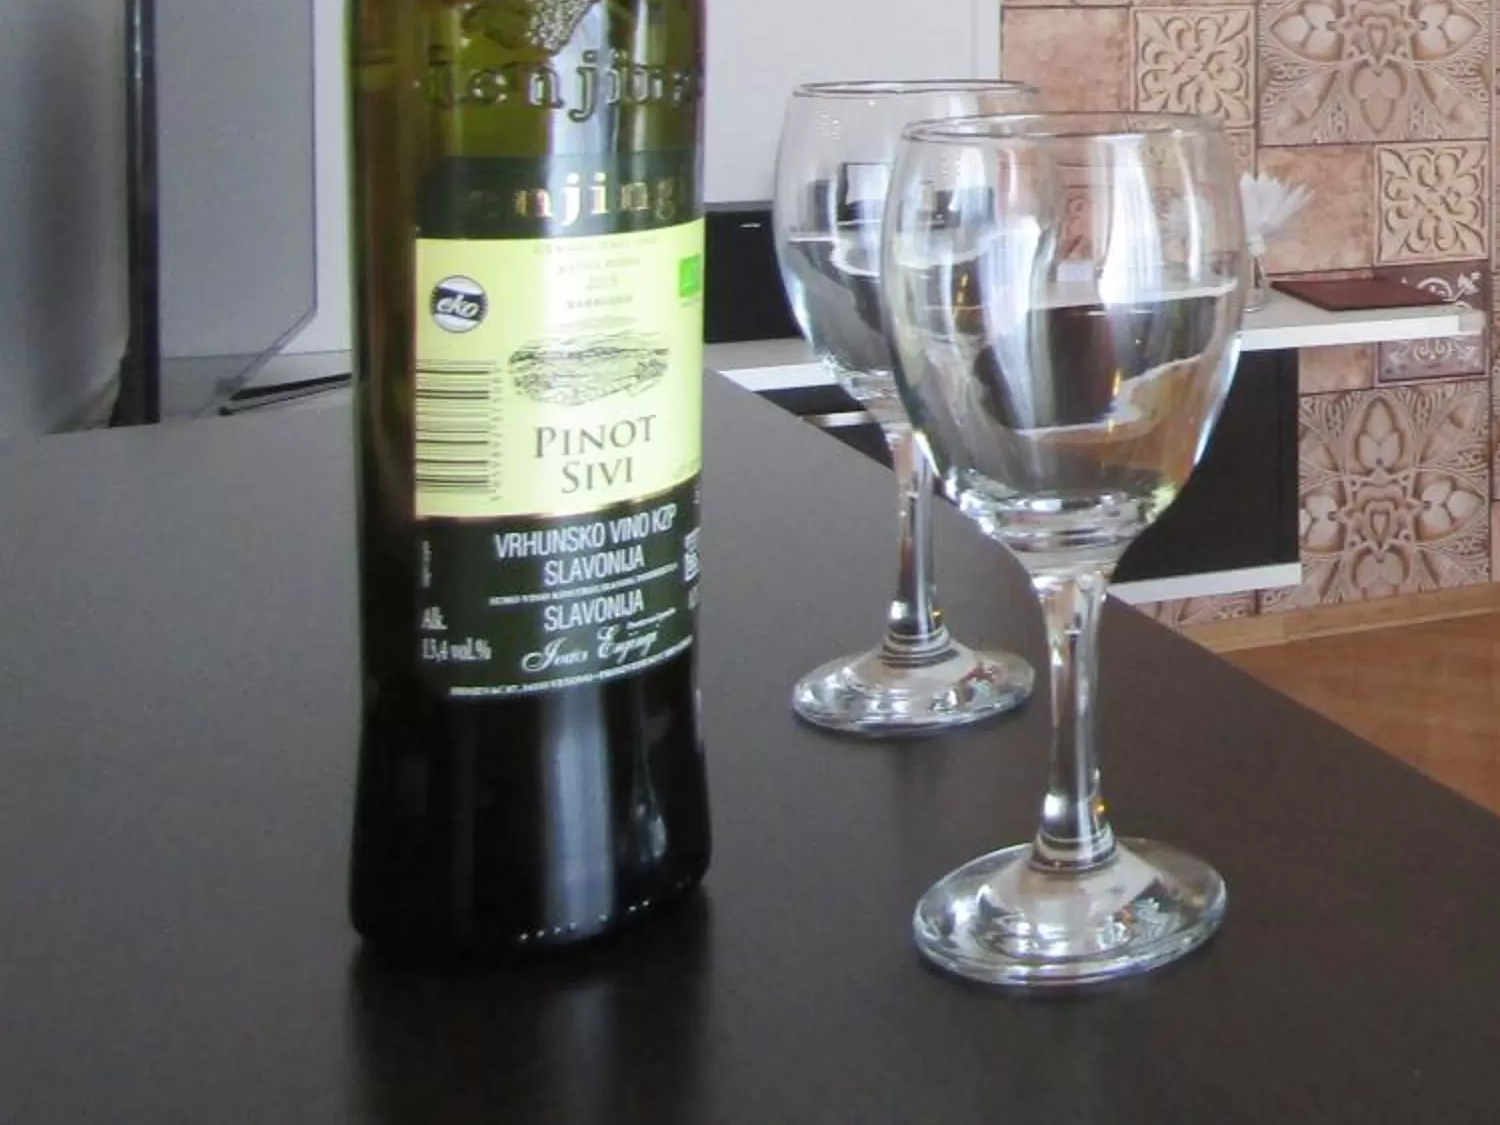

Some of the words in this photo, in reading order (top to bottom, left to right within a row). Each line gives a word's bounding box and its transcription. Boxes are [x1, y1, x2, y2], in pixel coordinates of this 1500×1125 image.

[435, 293, 480, 320] eko
[534, 415, 656, 459] PINOT
[561, 457, 633, 494] SIVI
[493, 522, 606, 559] VRHUNSKO
[608, 511, 650, 544] VINO
[543, 544, 645, 587] SLAVONIJA
[543, 588, 645, 632] SLAVONIJA
